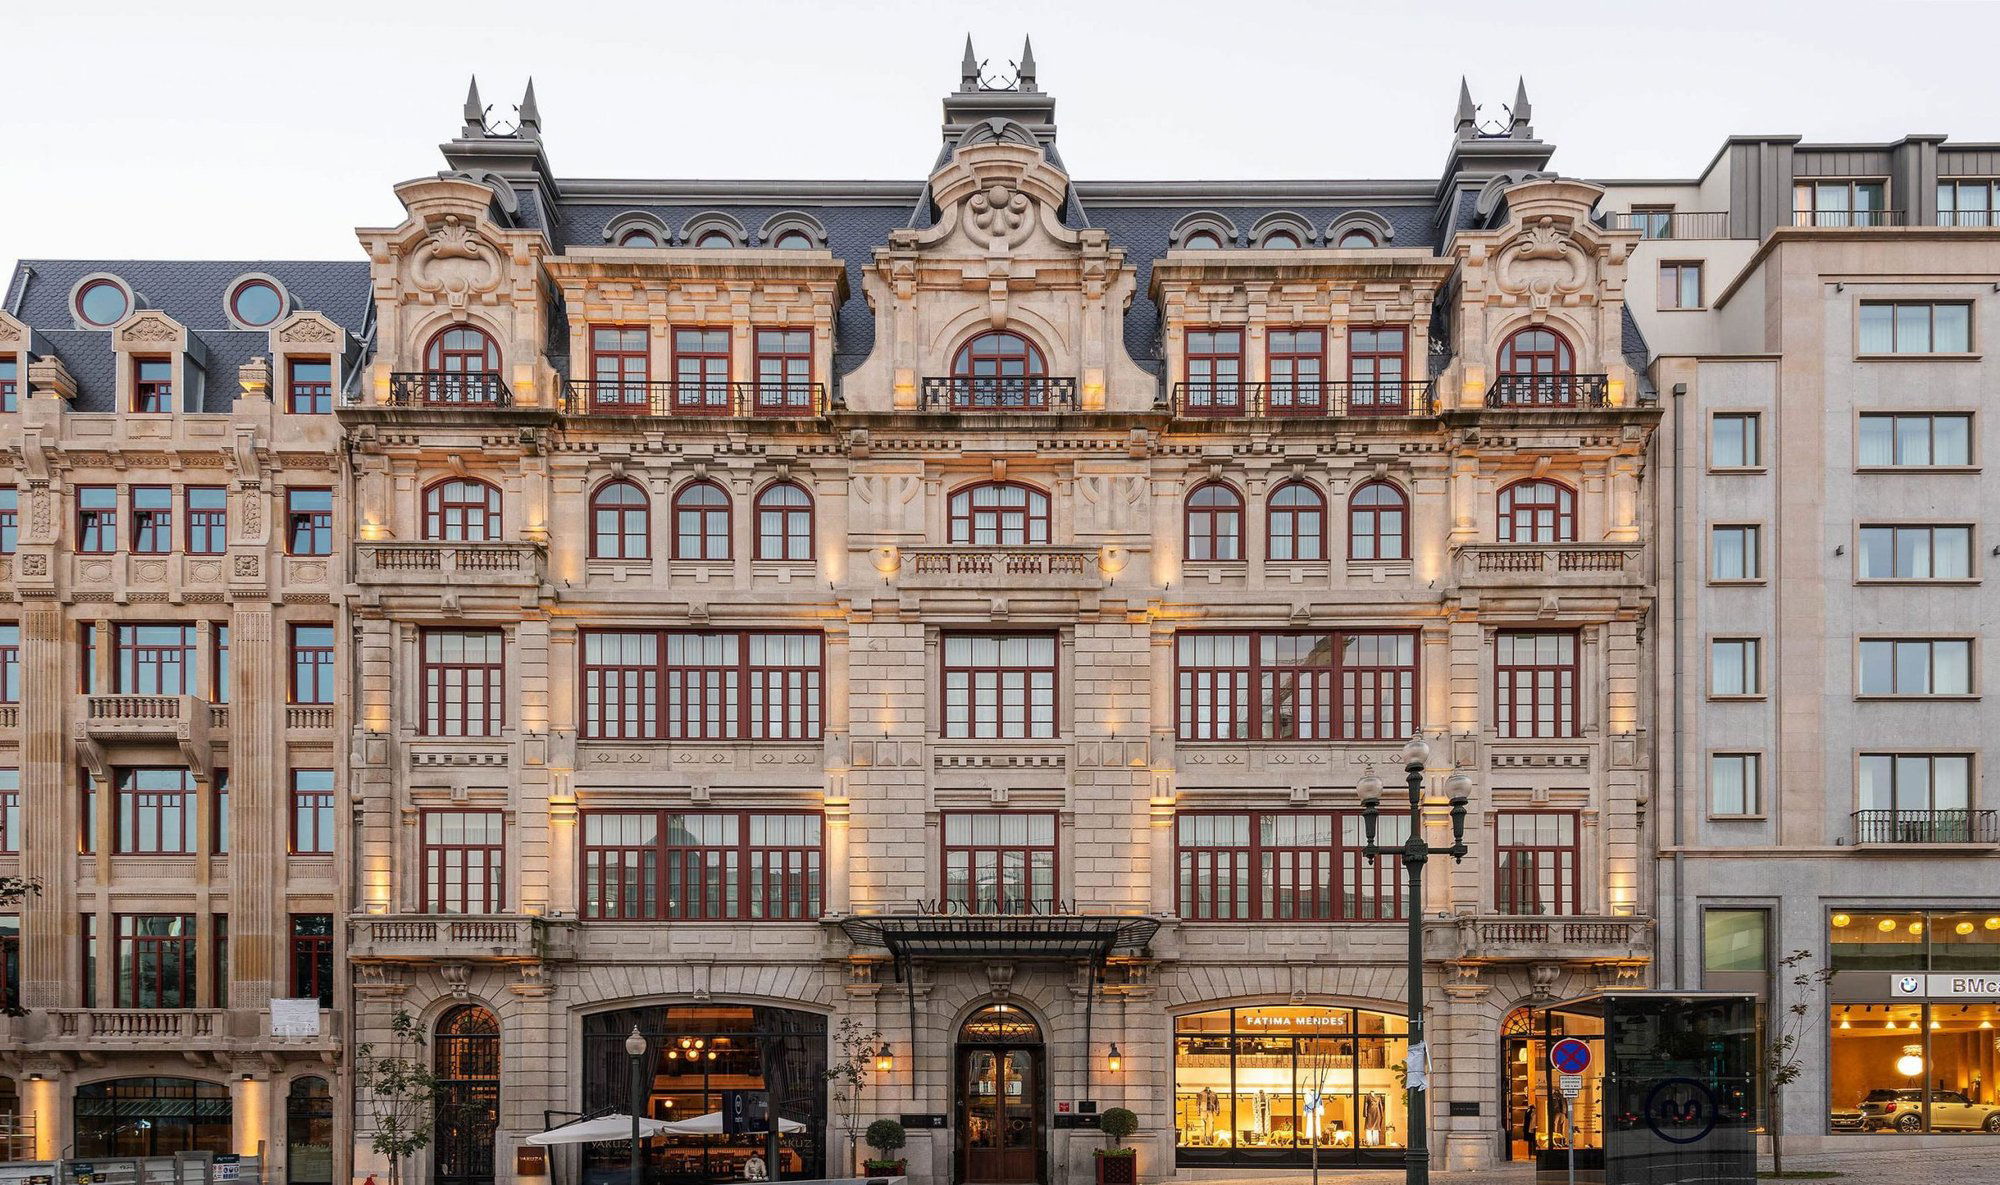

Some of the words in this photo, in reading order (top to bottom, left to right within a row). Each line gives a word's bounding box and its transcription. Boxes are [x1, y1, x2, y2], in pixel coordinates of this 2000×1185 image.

[1952, 978, 2000, 993] BMc
[1247, 1017, 1291, 1025] FATIMA
[1296, 1017, 1344, 1025] MENDES
[591, 1139, 633, 1149] YAKUZ
